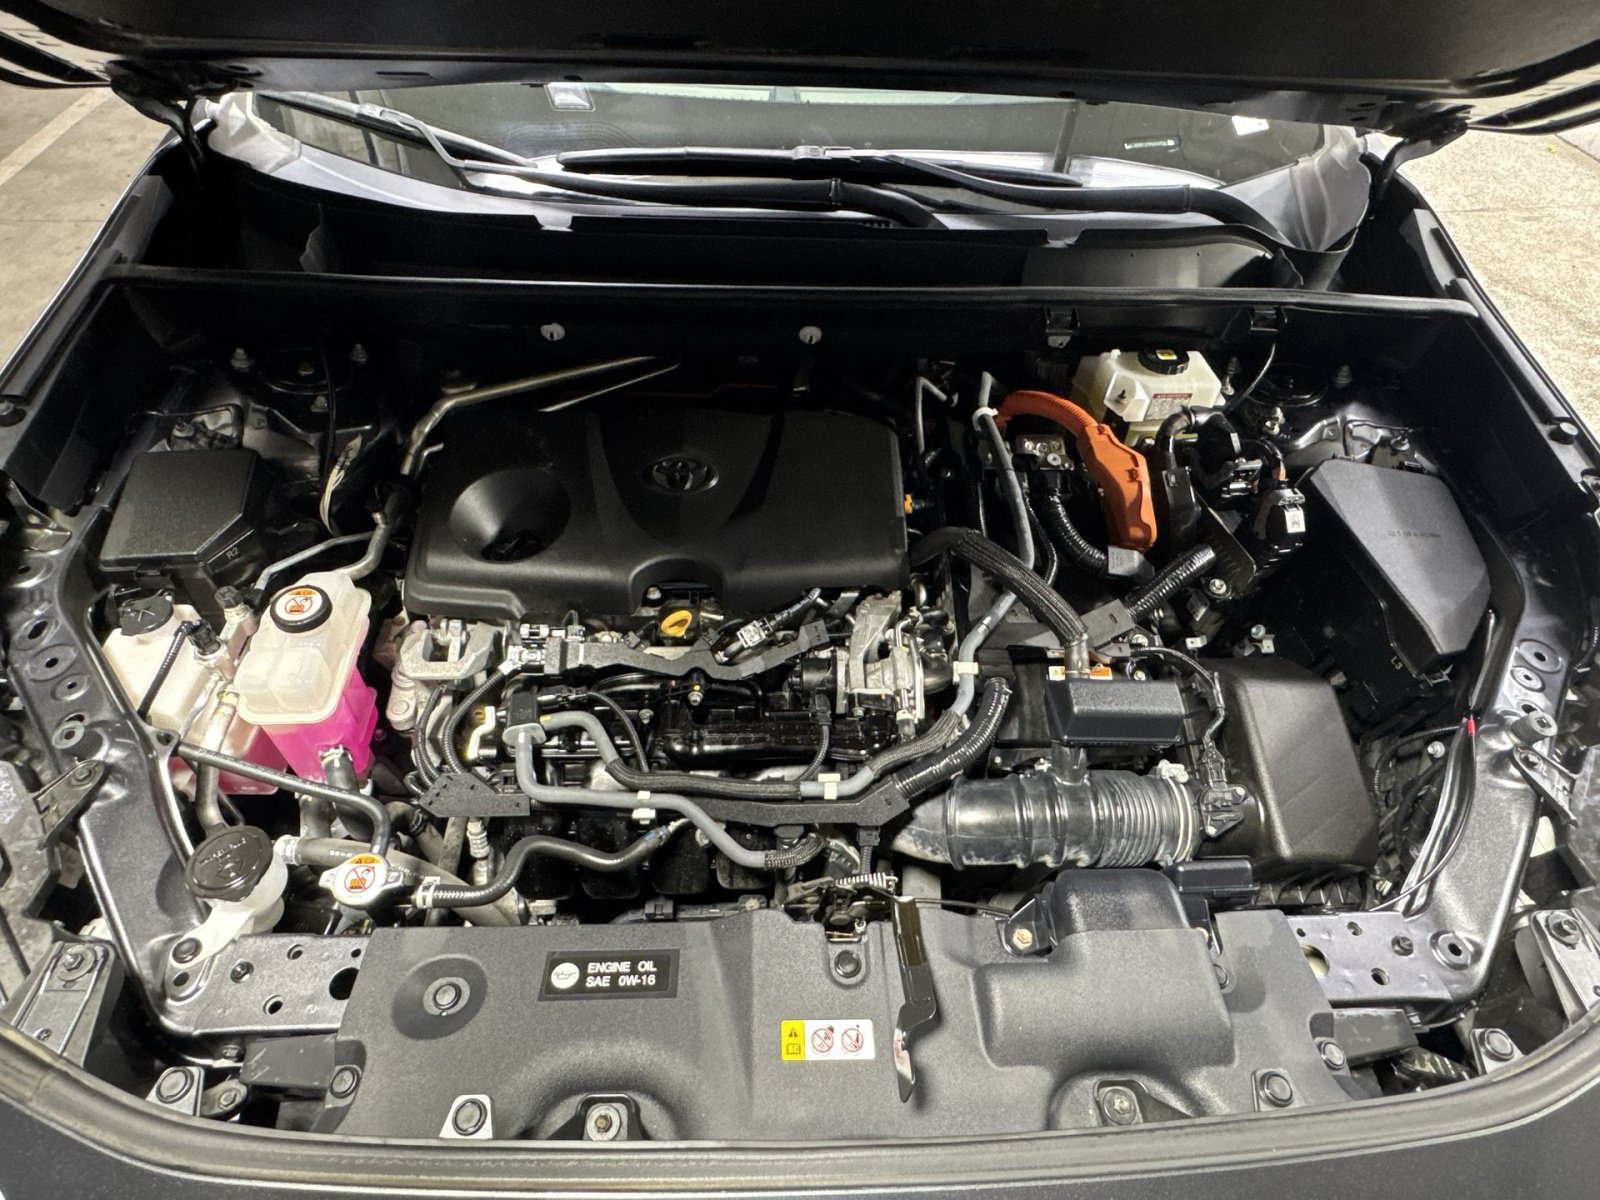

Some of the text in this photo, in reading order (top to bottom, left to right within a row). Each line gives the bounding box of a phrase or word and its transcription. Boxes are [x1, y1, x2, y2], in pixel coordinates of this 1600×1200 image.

[587, 960, 657, 974] ENGINE OIL
[585, 974, 656, 988] SAE 0W-16
